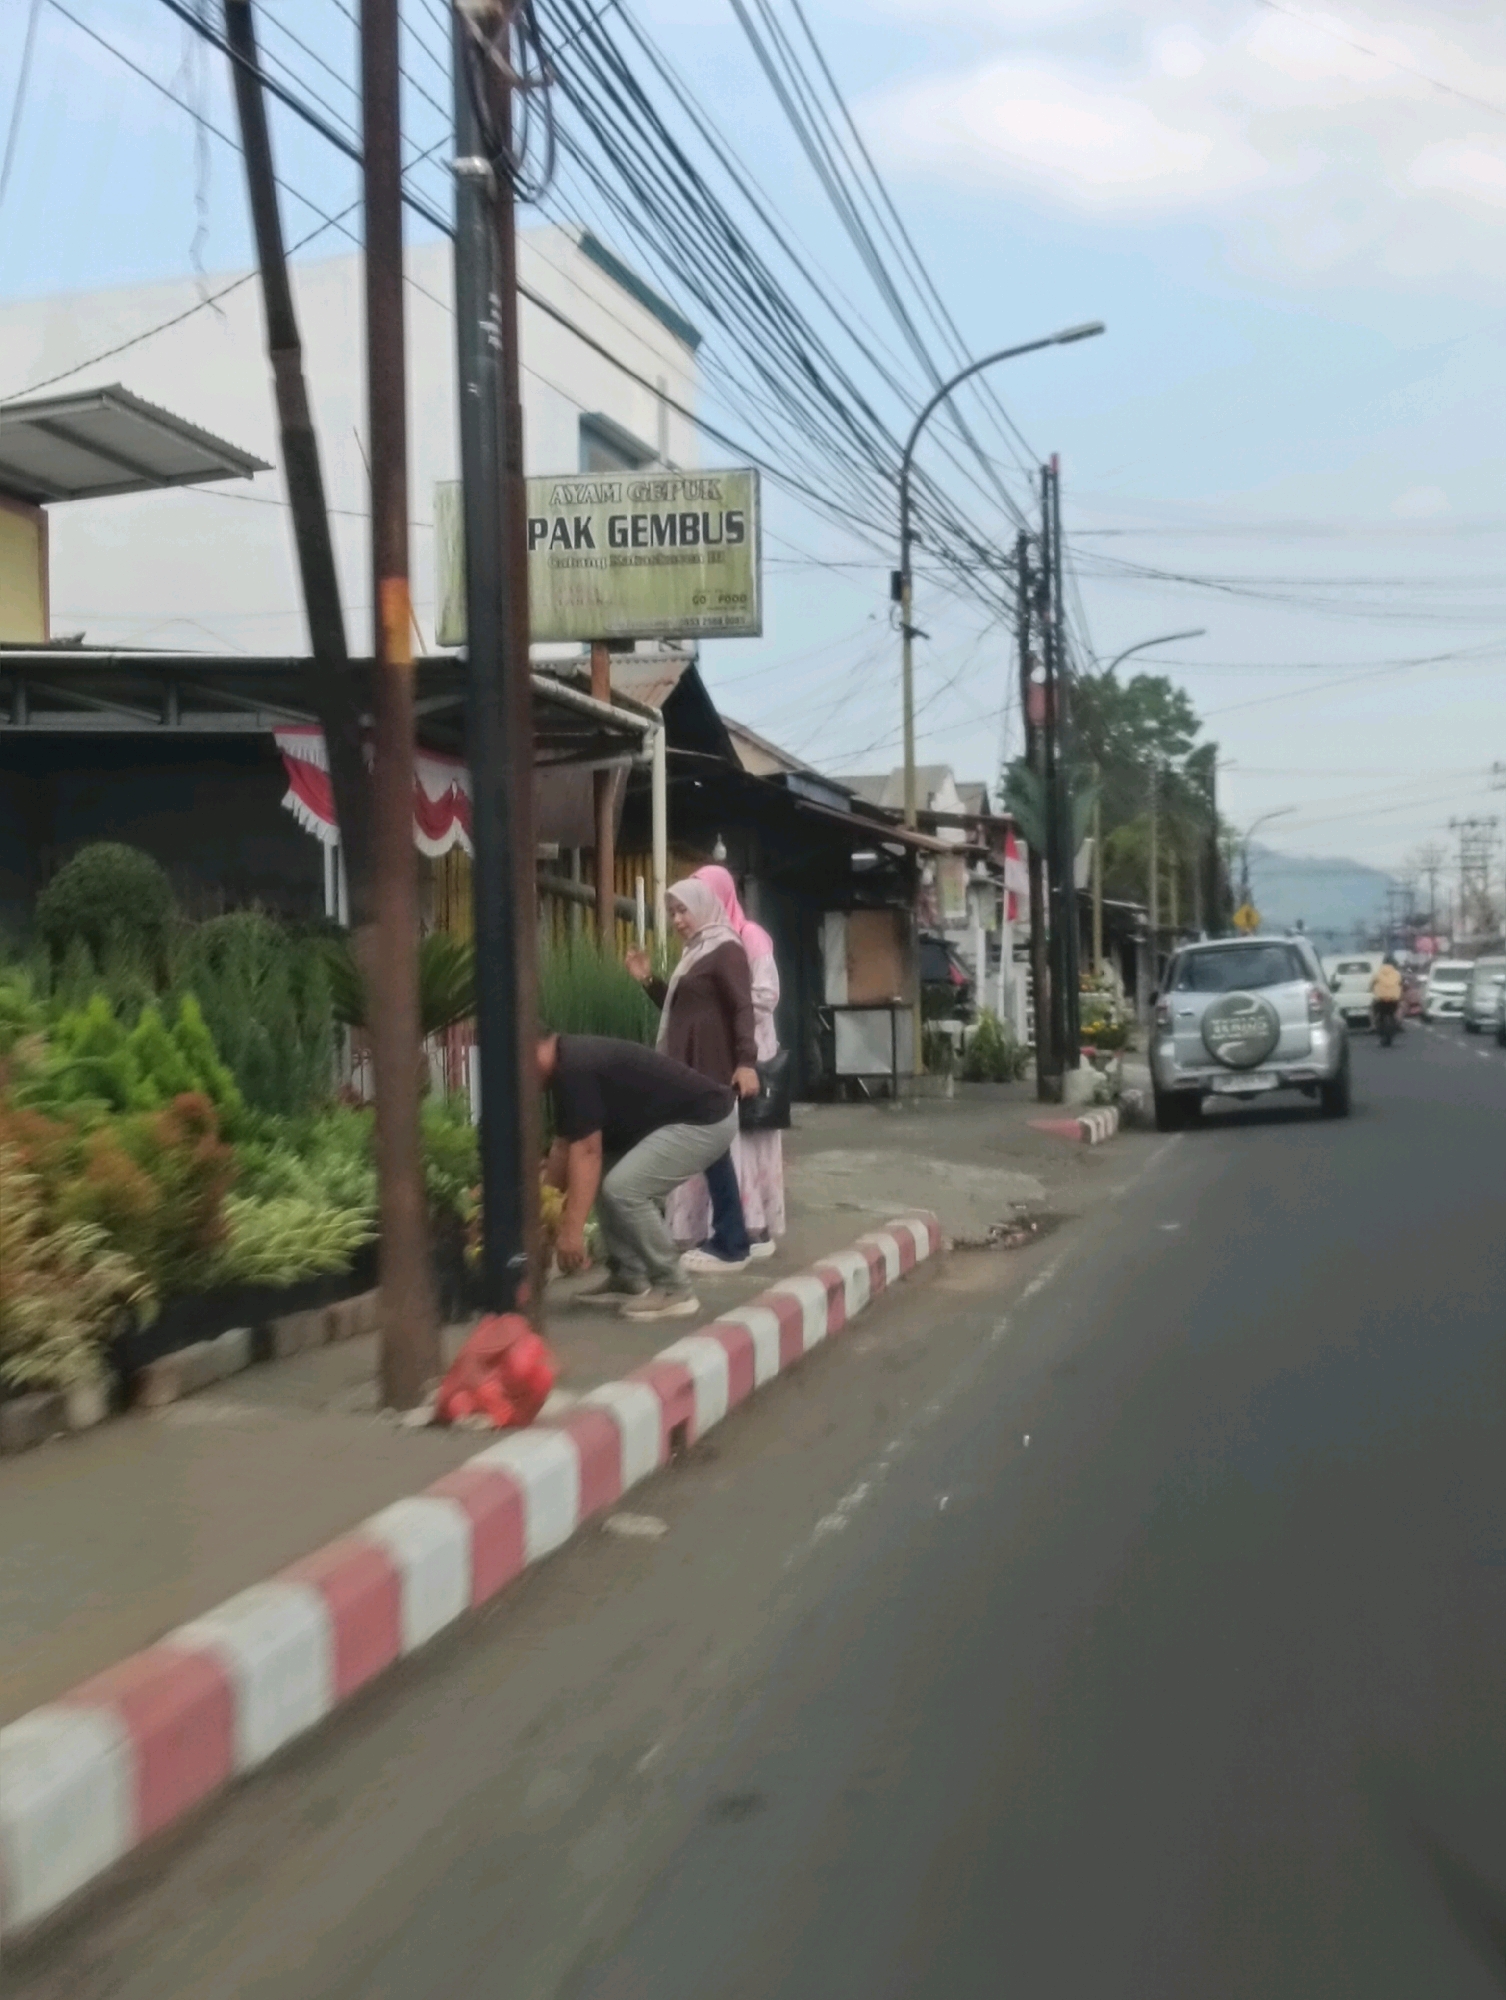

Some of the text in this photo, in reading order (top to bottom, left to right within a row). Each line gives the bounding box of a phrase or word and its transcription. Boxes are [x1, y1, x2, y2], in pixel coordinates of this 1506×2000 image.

[549, 478, 723, 505] AYAM GEPUK
[528, 510, 745, 550] PAK GEMBUS
